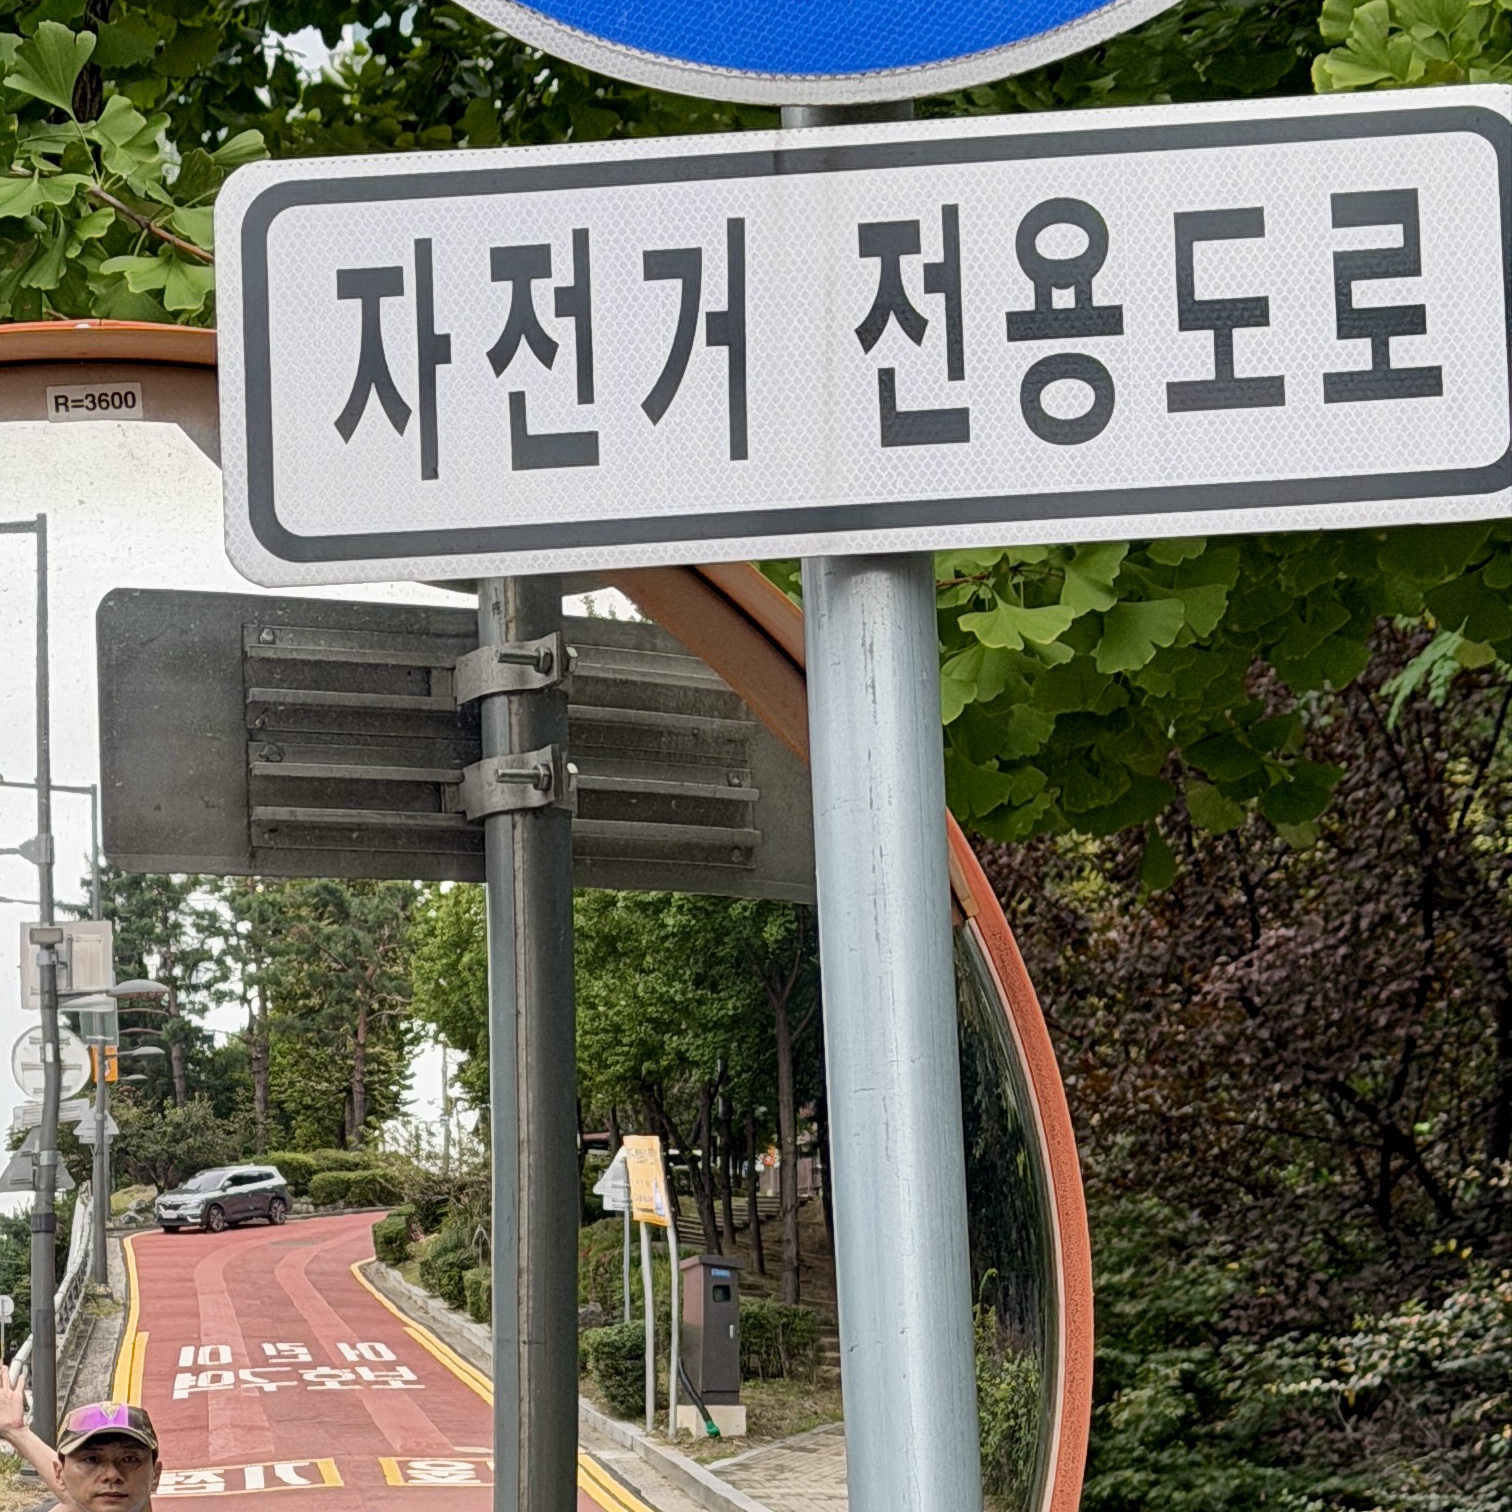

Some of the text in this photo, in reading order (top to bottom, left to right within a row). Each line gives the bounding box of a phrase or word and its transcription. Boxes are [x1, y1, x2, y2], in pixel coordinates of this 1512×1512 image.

[53, 390, 137, 414] R=3600
[332, 187, 1444, 482] 자전거 전용도로
